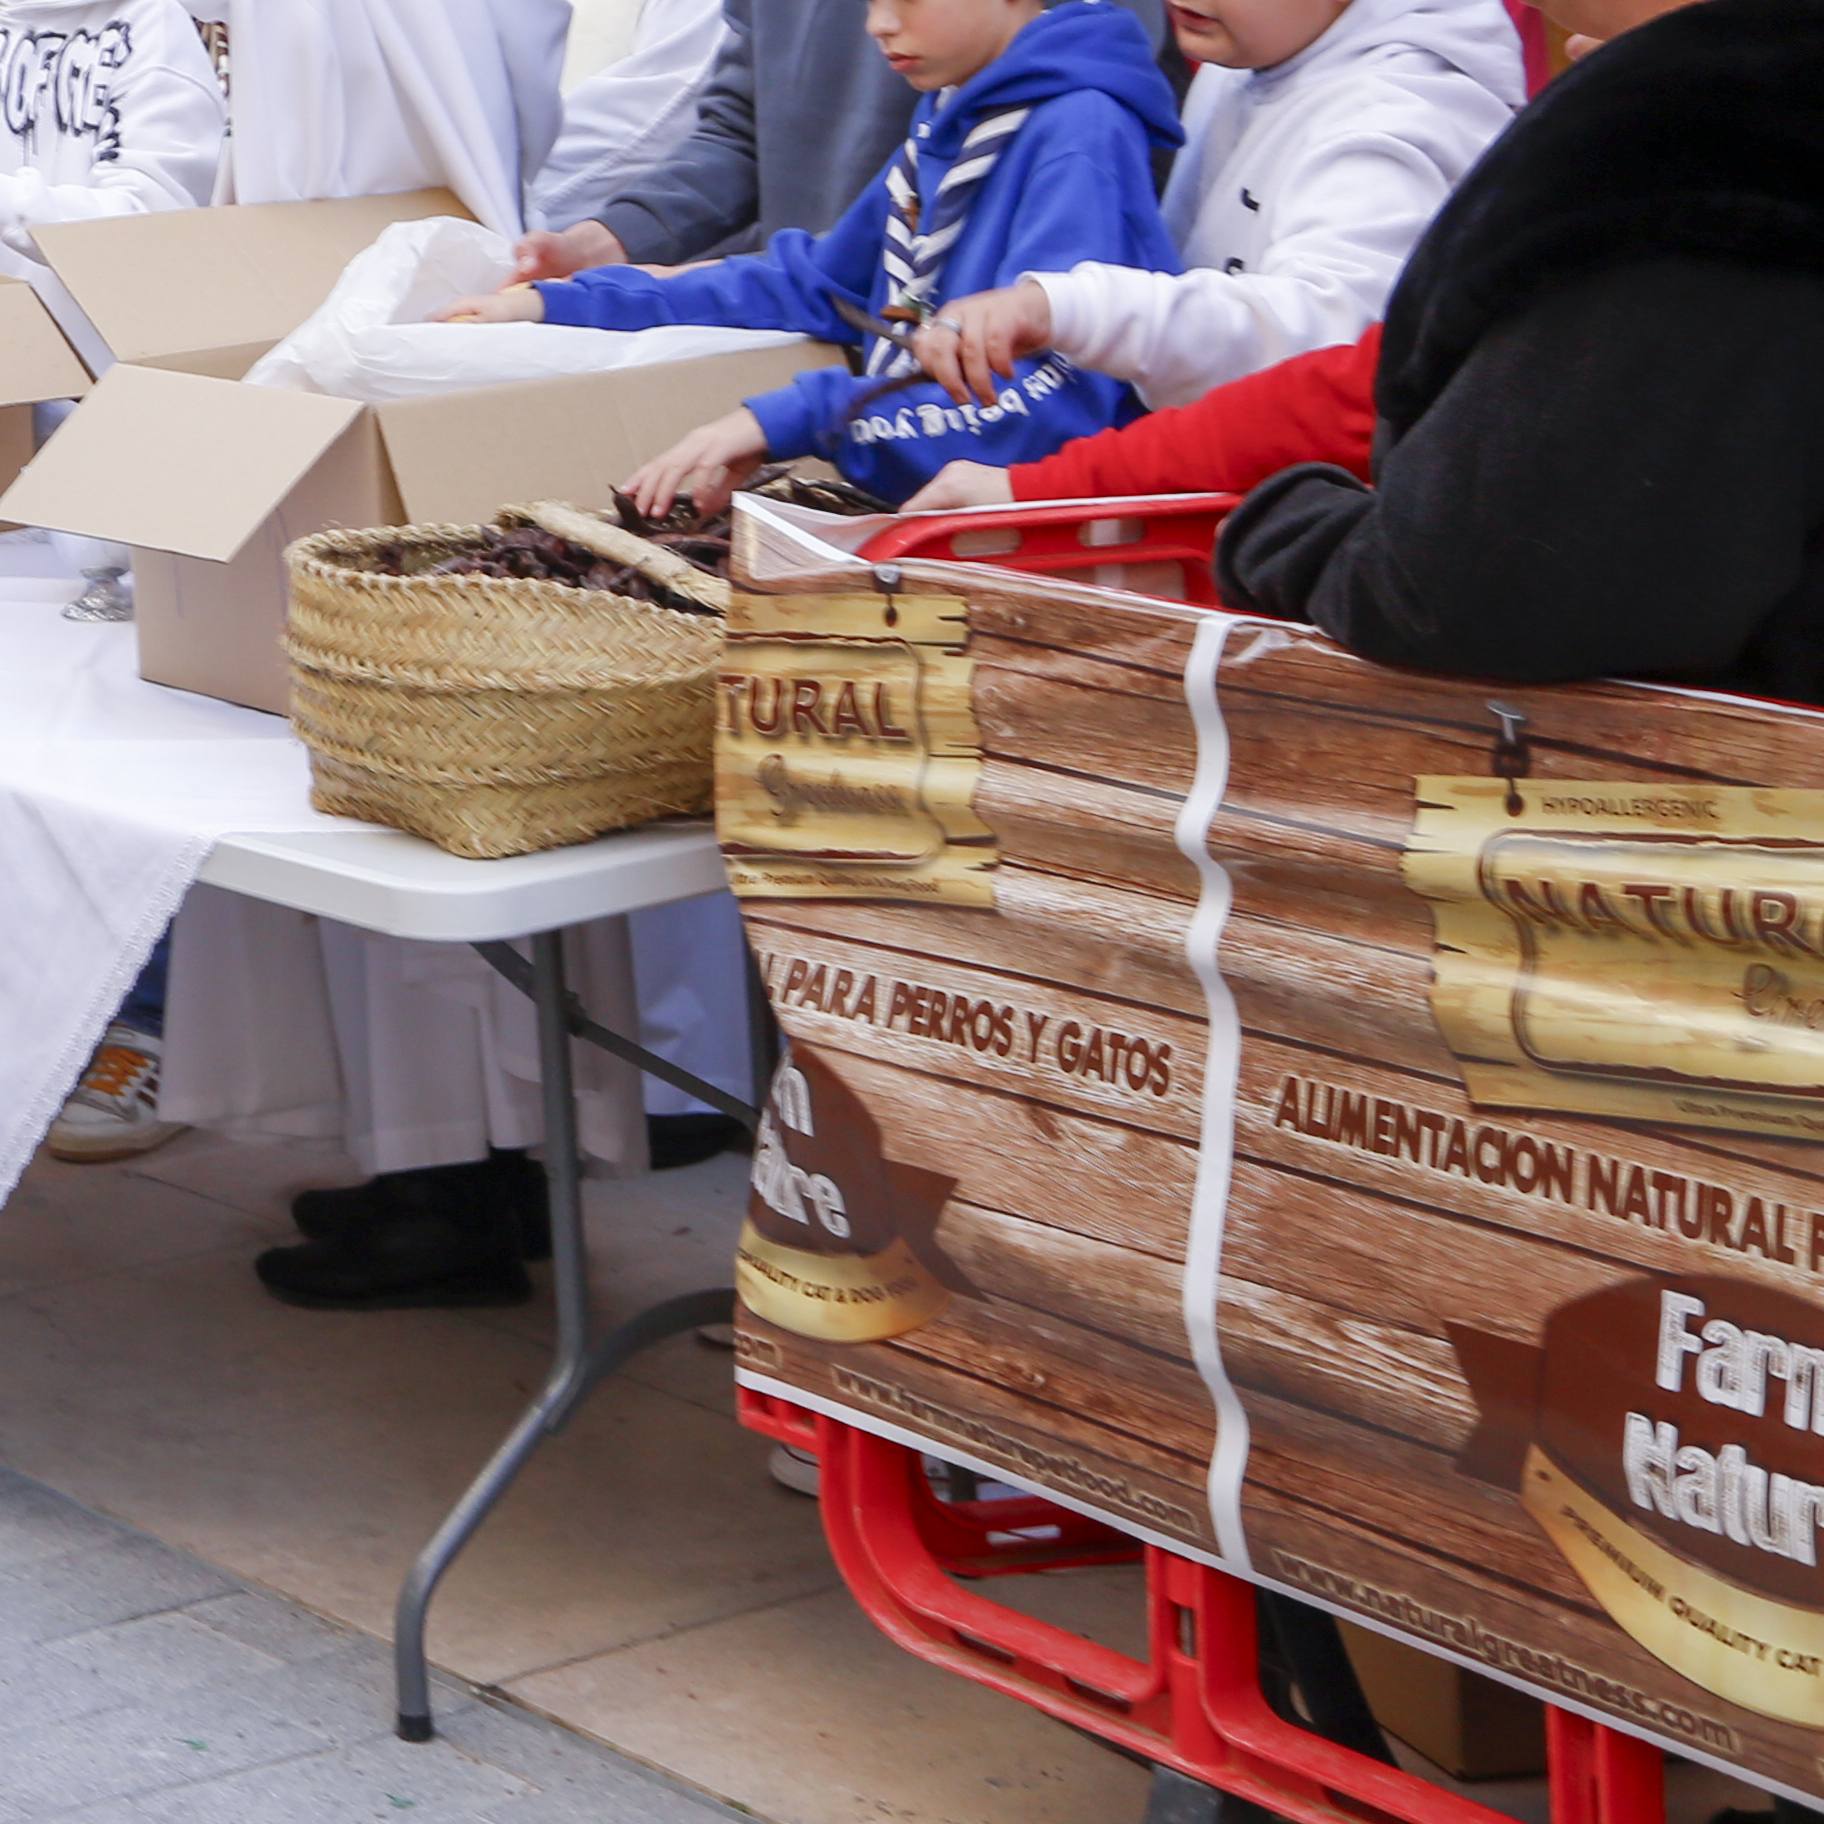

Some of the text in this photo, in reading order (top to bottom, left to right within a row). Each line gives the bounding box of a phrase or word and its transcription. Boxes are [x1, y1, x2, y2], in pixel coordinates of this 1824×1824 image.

[1540, 795, 1719, 819] HYPOALLERGENIC
[782, 956, 877, 1024] PARA
[888, 980, 1014, 1058] PERROS
[1025, 1012, 1053, 1064] Y
[1058, 1020, 1173, 1097] GATOS
[1274, 1076, 1574, 1205] ALIMENTACION
[1588, 1153, 1795, 1265] NATURAL
[1276, 1550, 1736, 1752] www.naturalgreatness.com
[1559, 1503, 1824, 1678] PREMIUM QUALITY CAT
